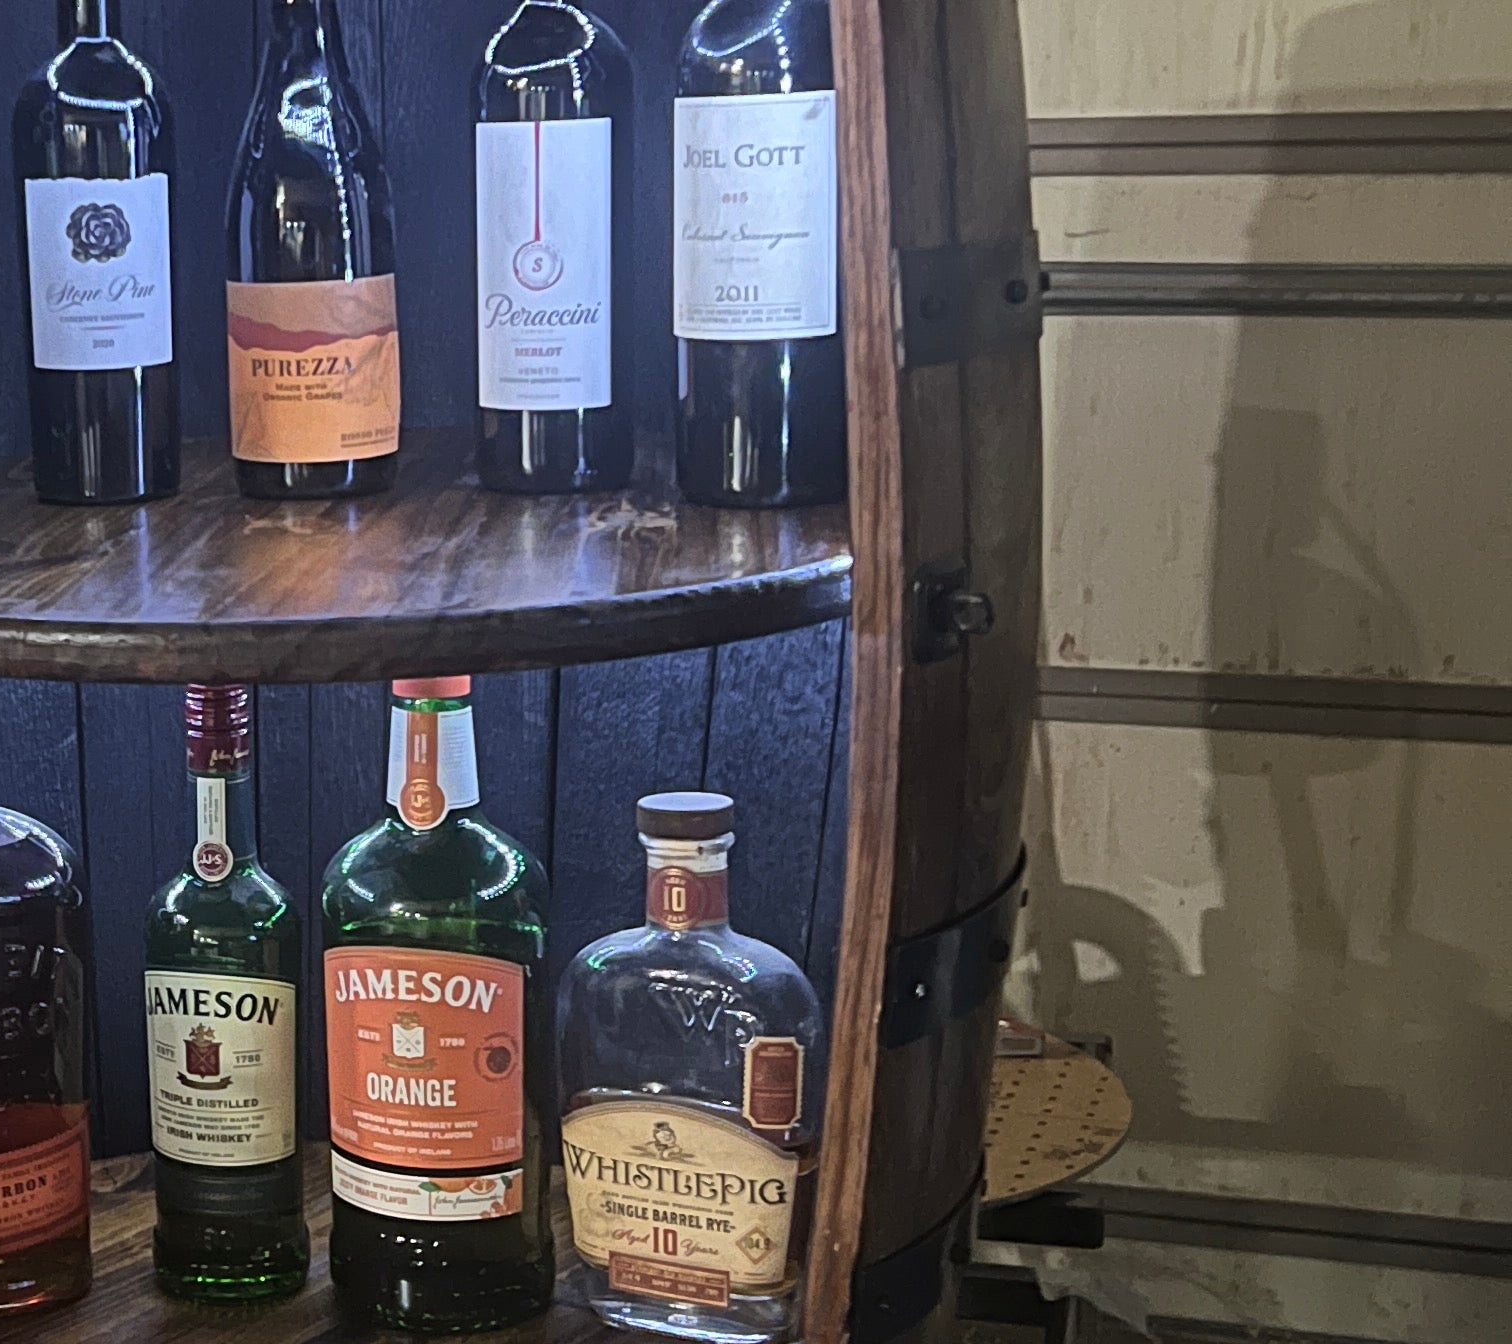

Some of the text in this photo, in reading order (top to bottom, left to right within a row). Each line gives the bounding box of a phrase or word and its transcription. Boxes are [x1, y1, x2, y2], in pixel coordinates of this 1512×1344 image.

[682, 143, 806, 169] JOEL GOTT
[714, 284, 759, 303] 2011
[485, 293, 602, 329] Peraccini
[514, 346, 564, 357] MERLOT
[251, 356, 356, 377] PUREZZA
[663, 885, 686, 912] 10
[336, 968, 497, 1013] JAMESON
[148, 986, 280, 1026] JAMESON
[159, 1088, 260, 1109] TRIPLE DISTILLED
[366, 1071, 458, 1107] ORANGE
[196, 1132, 253, 1144] WHISKEY
[562, 1138, 788, 1206] WHISTLEPIG
[652, 1209, 704, 1230] BARREL
[612, 1226, 719, 1257] Aged 10 Years
